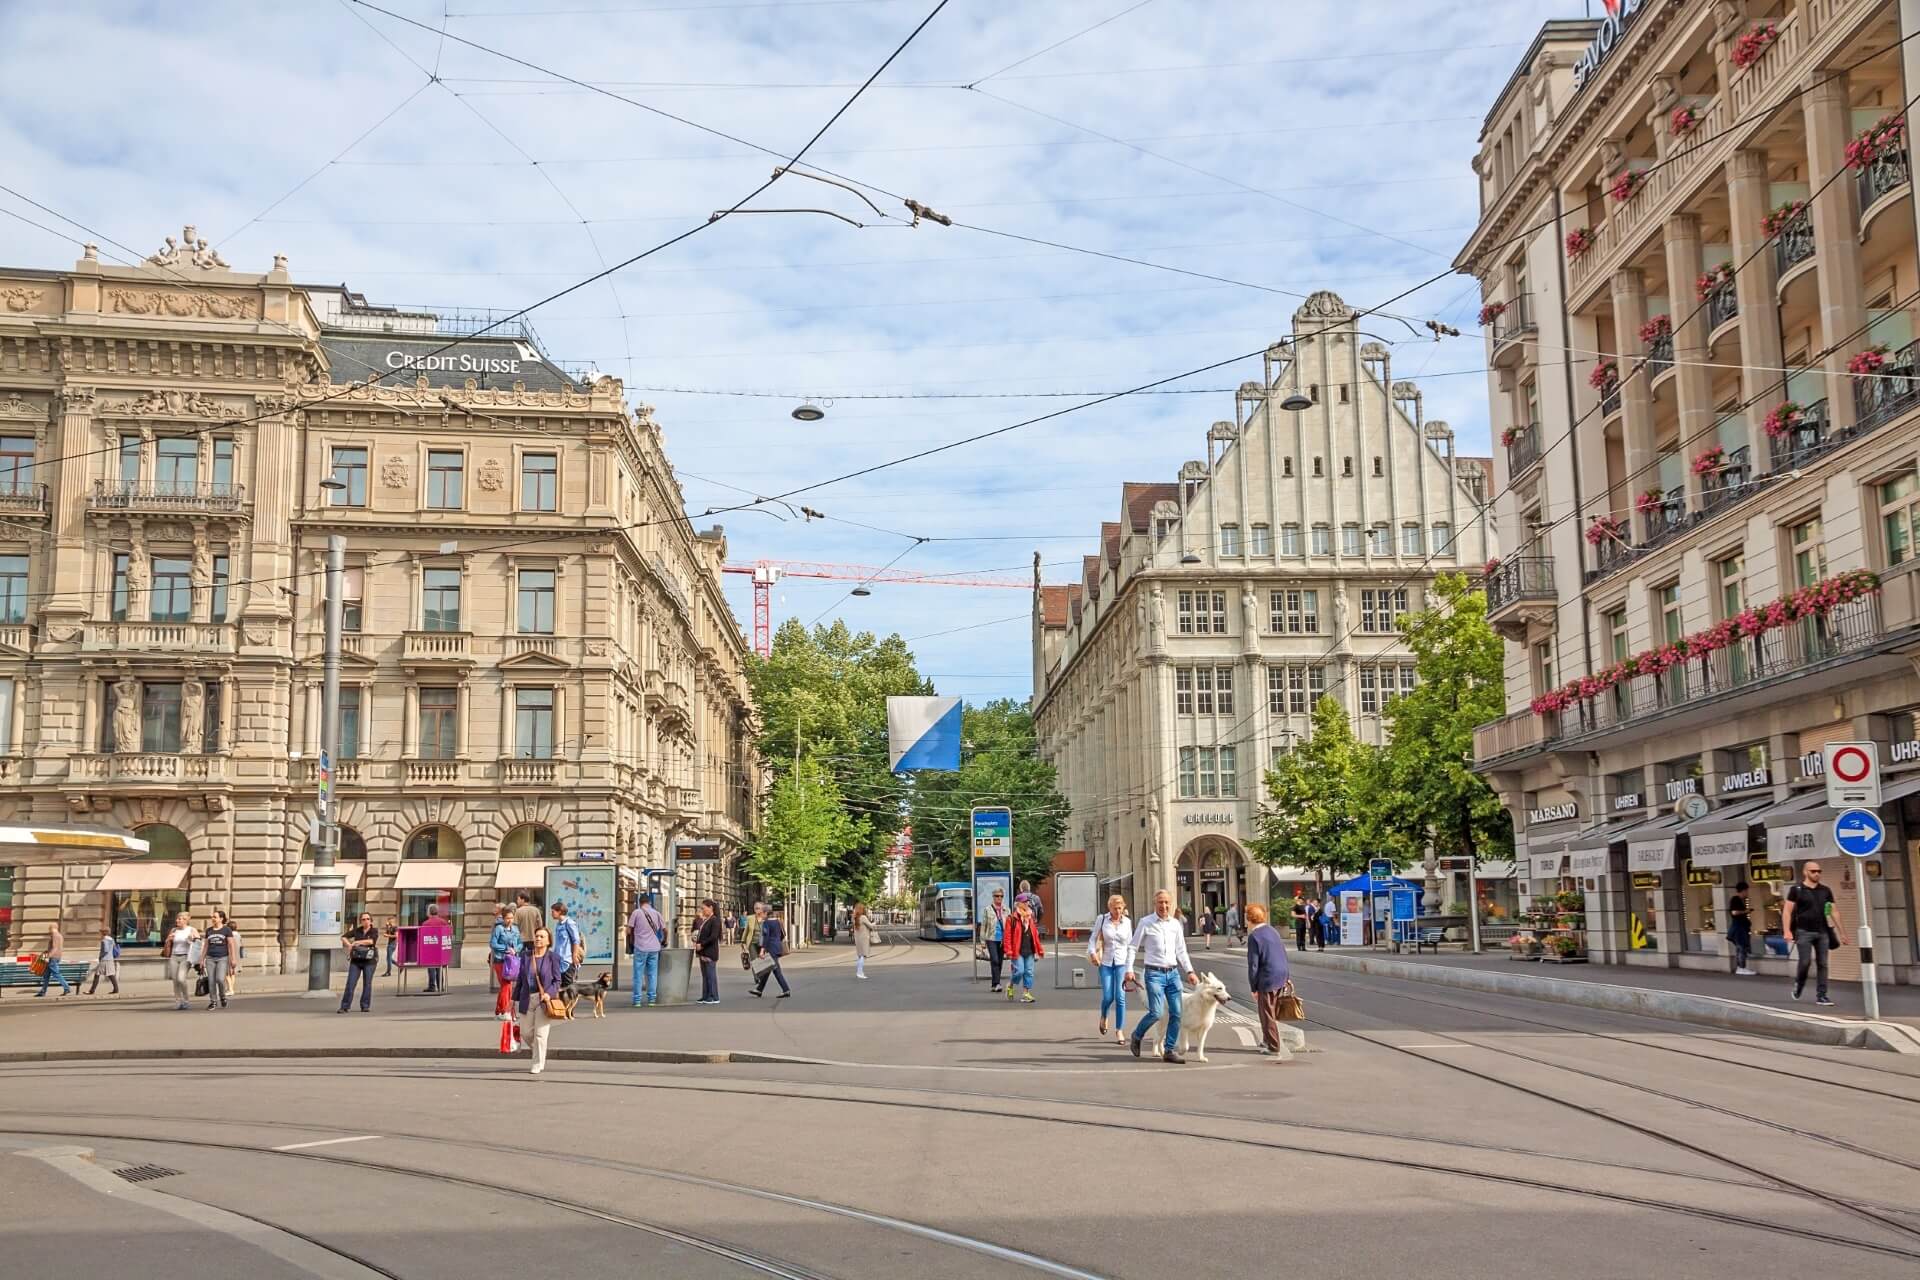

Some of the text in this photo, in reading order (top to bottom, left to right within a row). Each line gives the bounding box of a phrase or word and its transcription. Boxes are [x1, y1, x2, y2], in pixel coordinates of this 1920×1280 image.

[1573, 10, 1620, 91] SAVOY
[1722, 768, 1768, 792] JUWELEN
[1615, 794, 1639, 809] UHREN
[1530, 804, 1576, 824] MARSANO
[1785, 832, 1815, 850] TÜRLER
